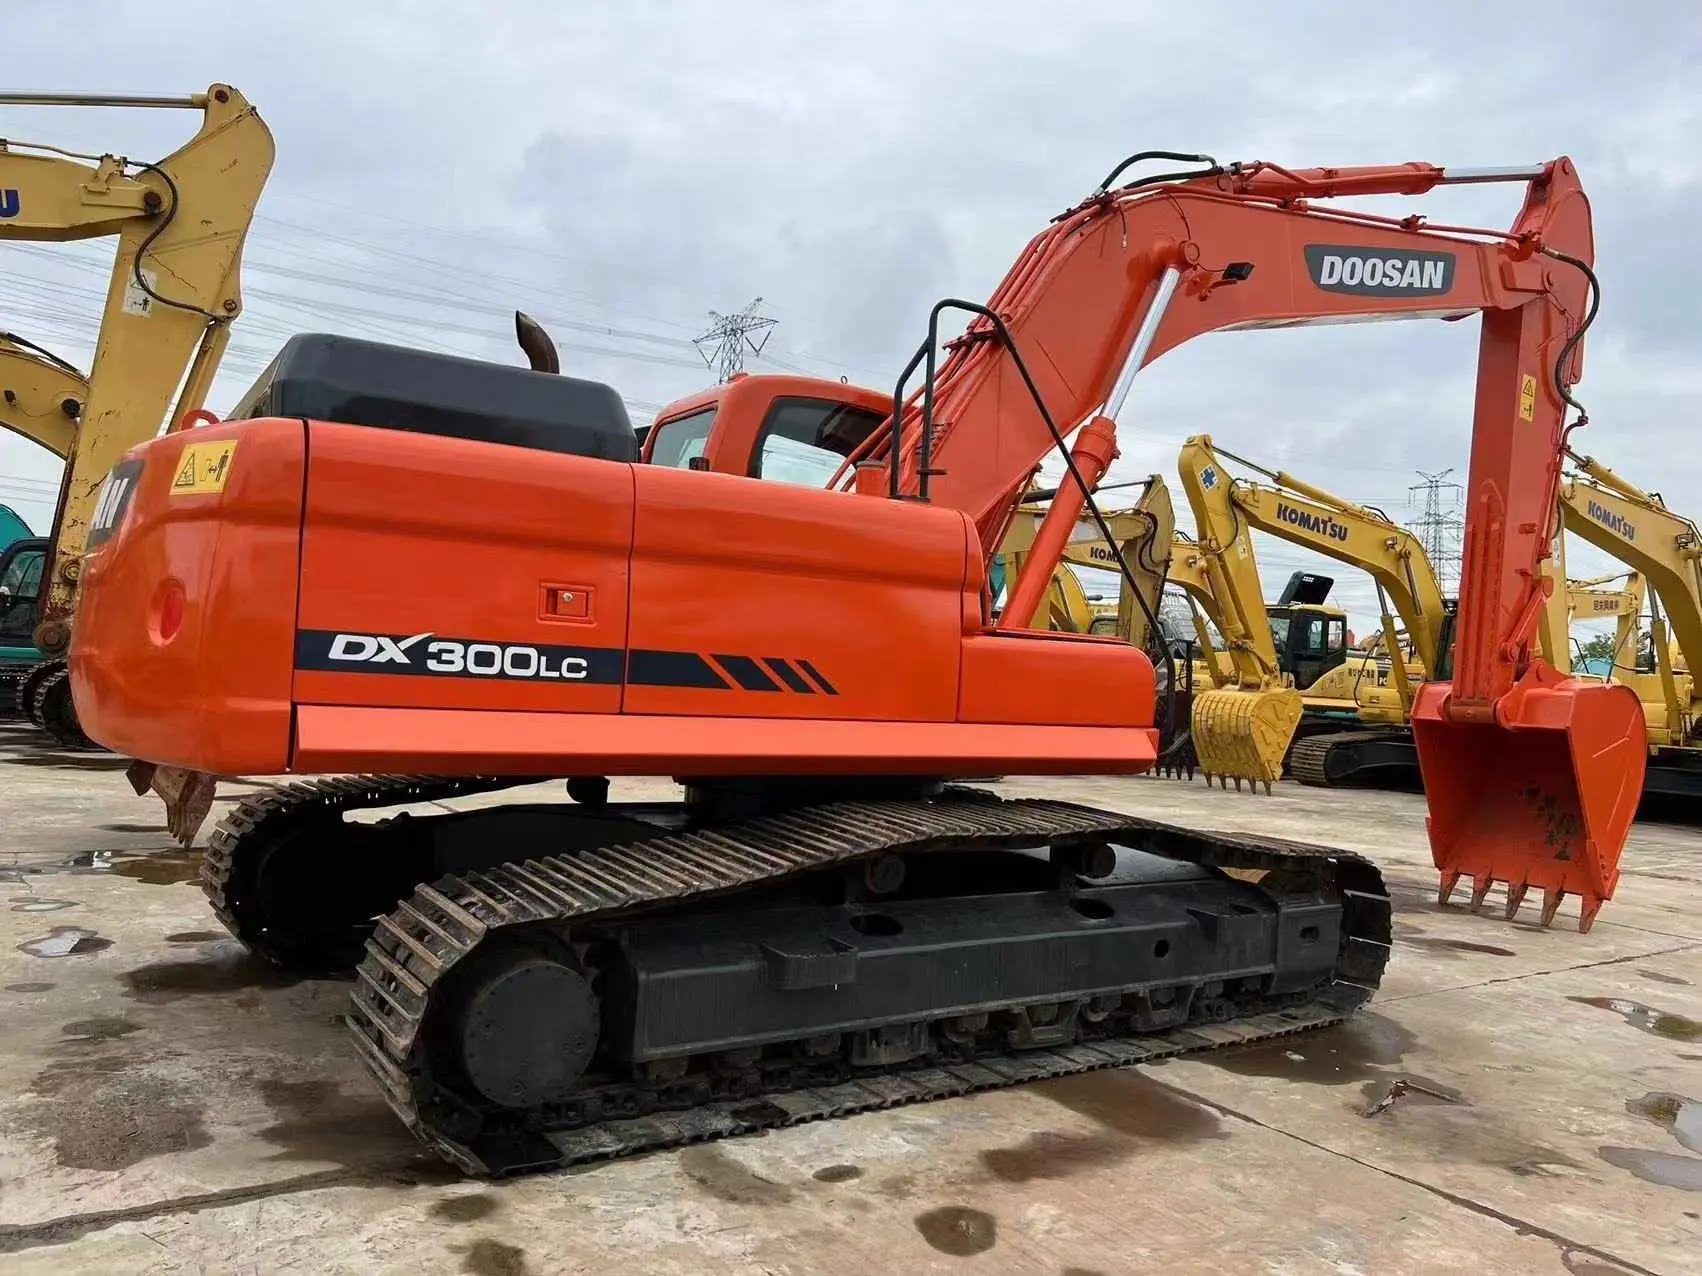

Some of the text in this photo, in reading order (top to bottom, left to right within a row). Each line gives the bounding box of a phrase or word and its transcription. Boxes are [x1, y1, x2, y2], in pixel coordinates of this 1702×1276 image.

[1320, 255, 1445, 289] DOOSAN
[1277, 502, 1348, 541] KOMATSU
[1588, 500, 1635, 541] KOMATSU
